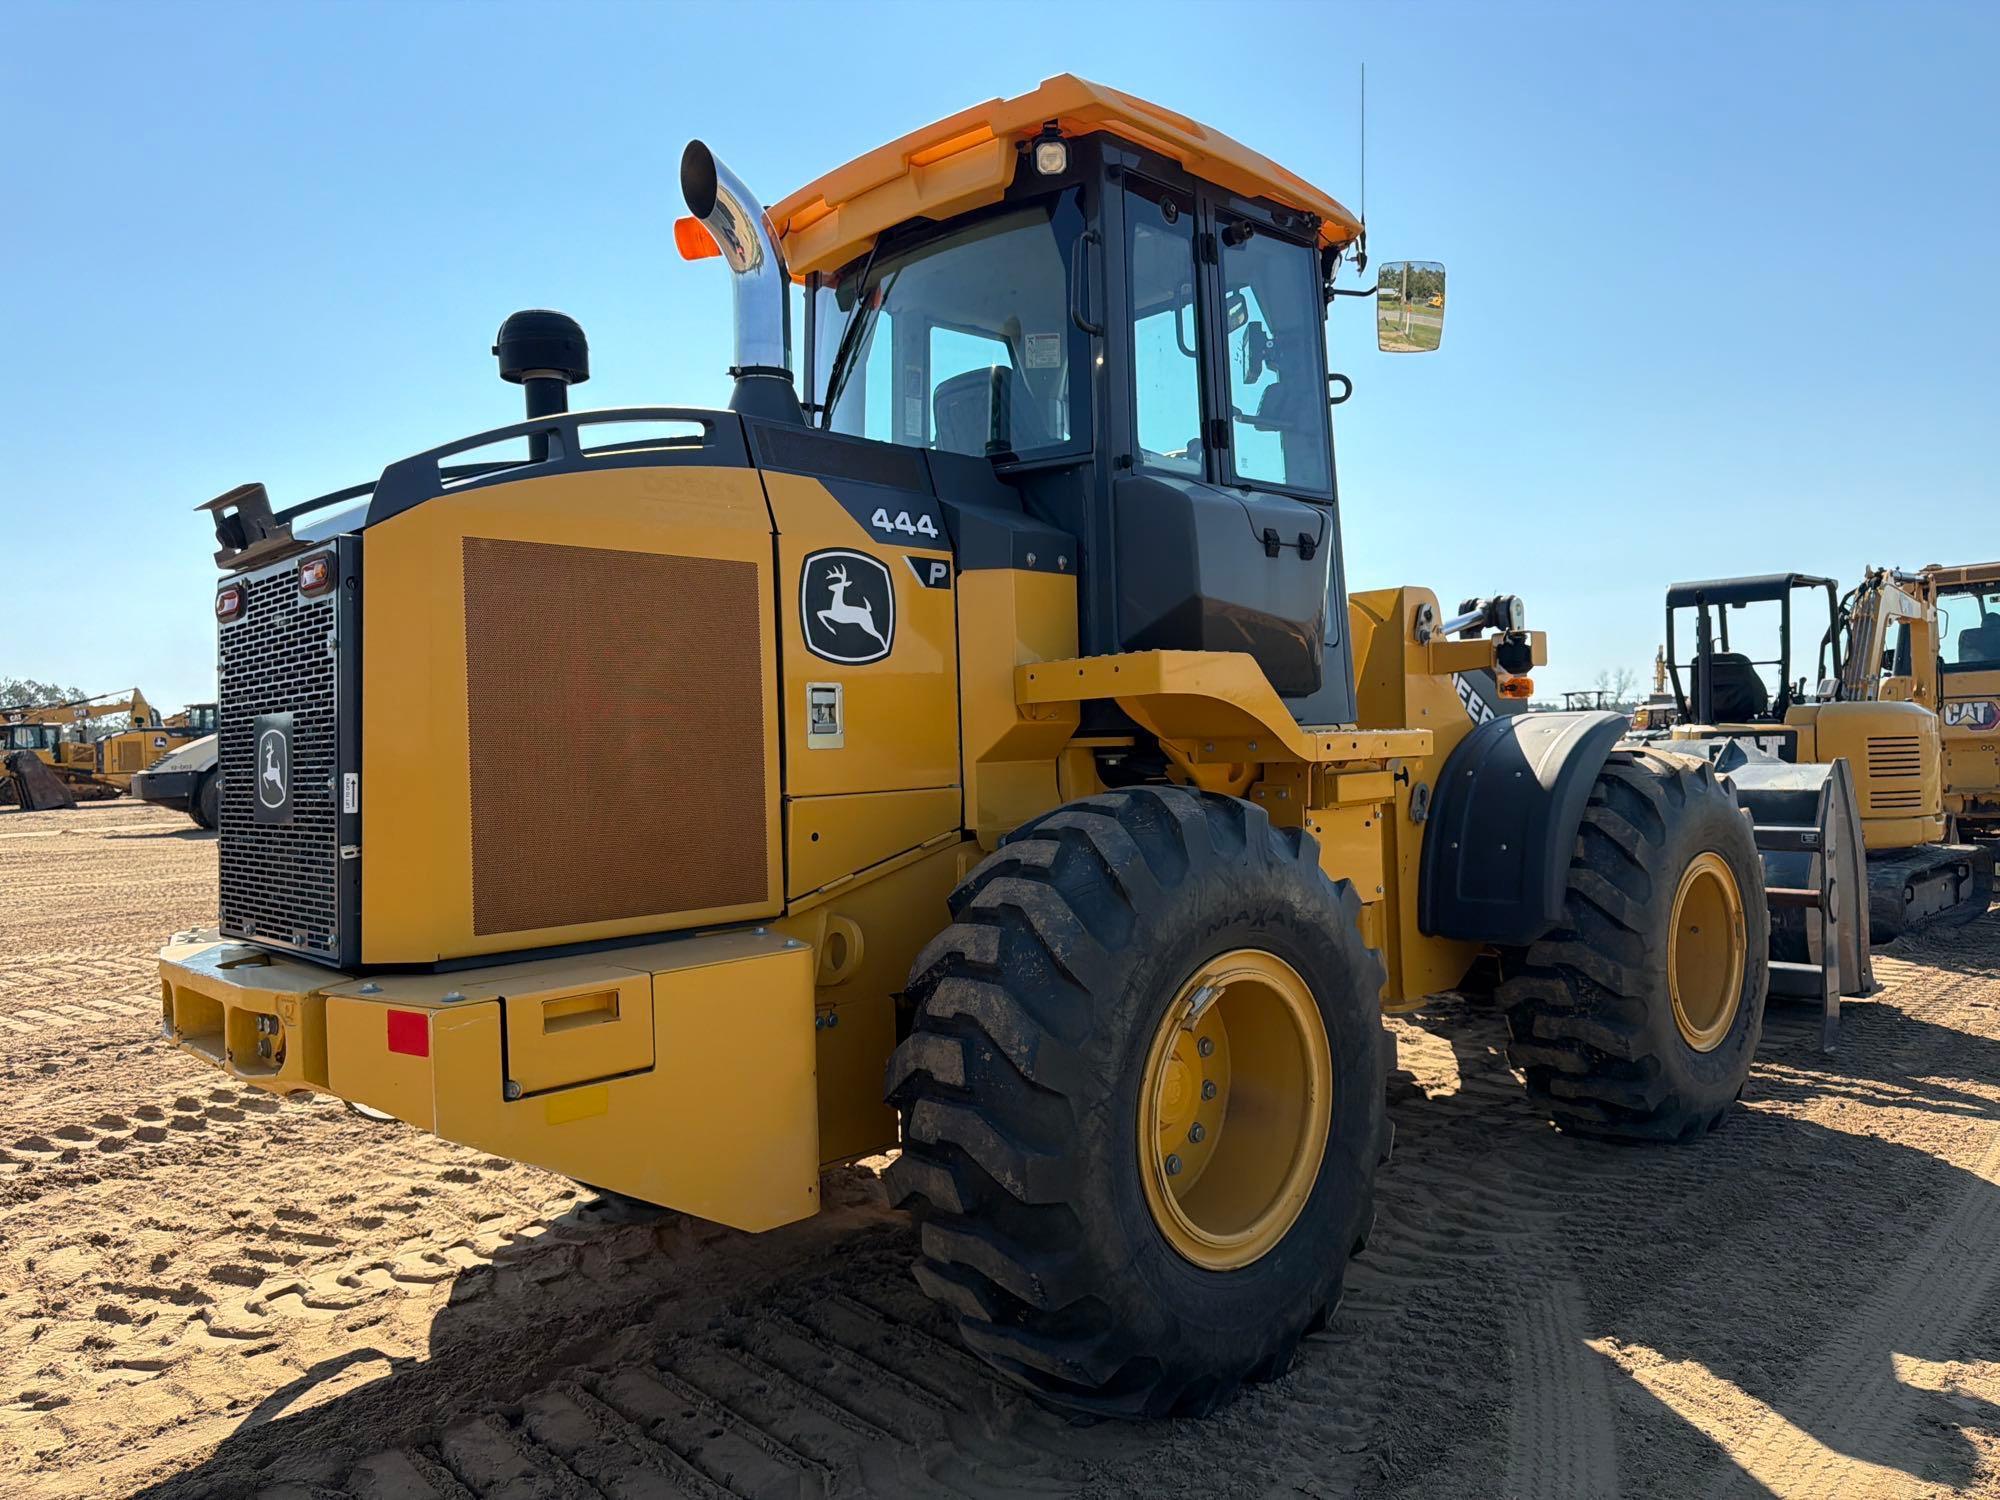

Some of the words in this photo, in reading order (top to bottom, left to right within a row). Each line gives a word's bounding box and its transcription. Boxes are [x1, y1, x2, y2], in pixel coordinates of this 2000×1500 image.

[871, 508, 939, 538] 444
[929, 563, 947, 585] P
[1452, 672, 1495, 725] EER
[9, 714, 22, 722] CAT
[1945, 702, 1989, 725] CAT
